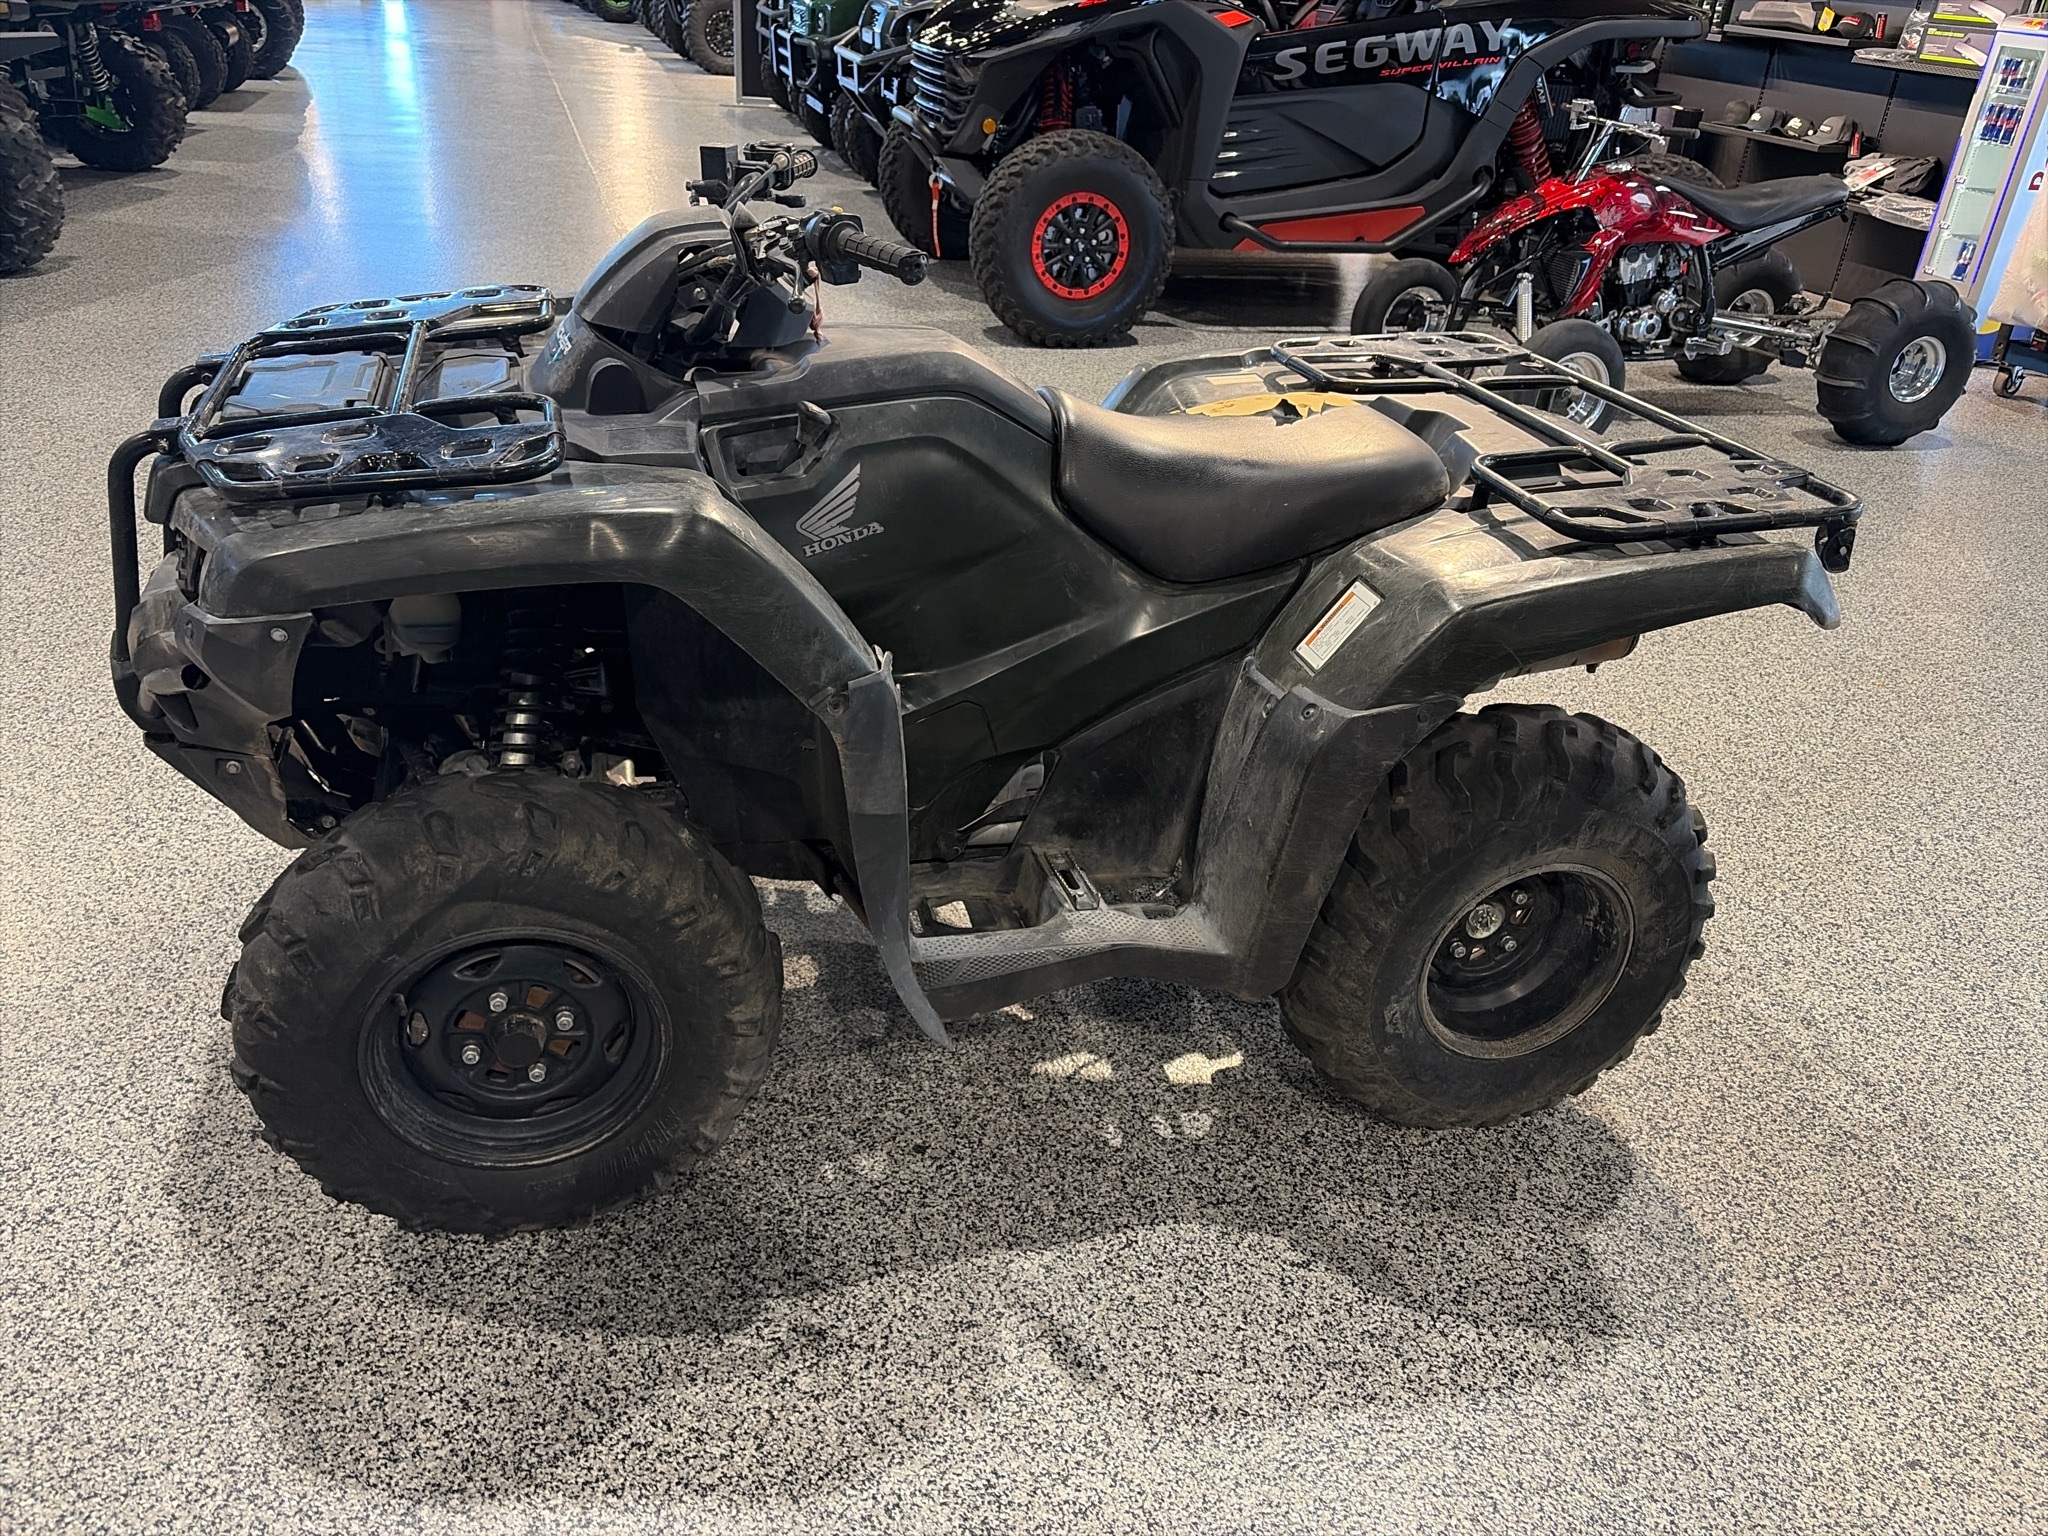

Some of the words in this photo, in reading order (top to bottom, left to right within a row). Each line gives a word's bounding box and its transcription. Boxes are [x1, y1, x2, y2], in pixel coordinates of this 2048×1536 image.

[1274, 18, 1513, 80] SEGWAY
[1379, 64, 1434, 77] SUPER
[1438, 56, 1501, 69] VILLAIN
[803, 521, 885, 557] HONDA
[1321, 604, 1344, 629] WARNING
